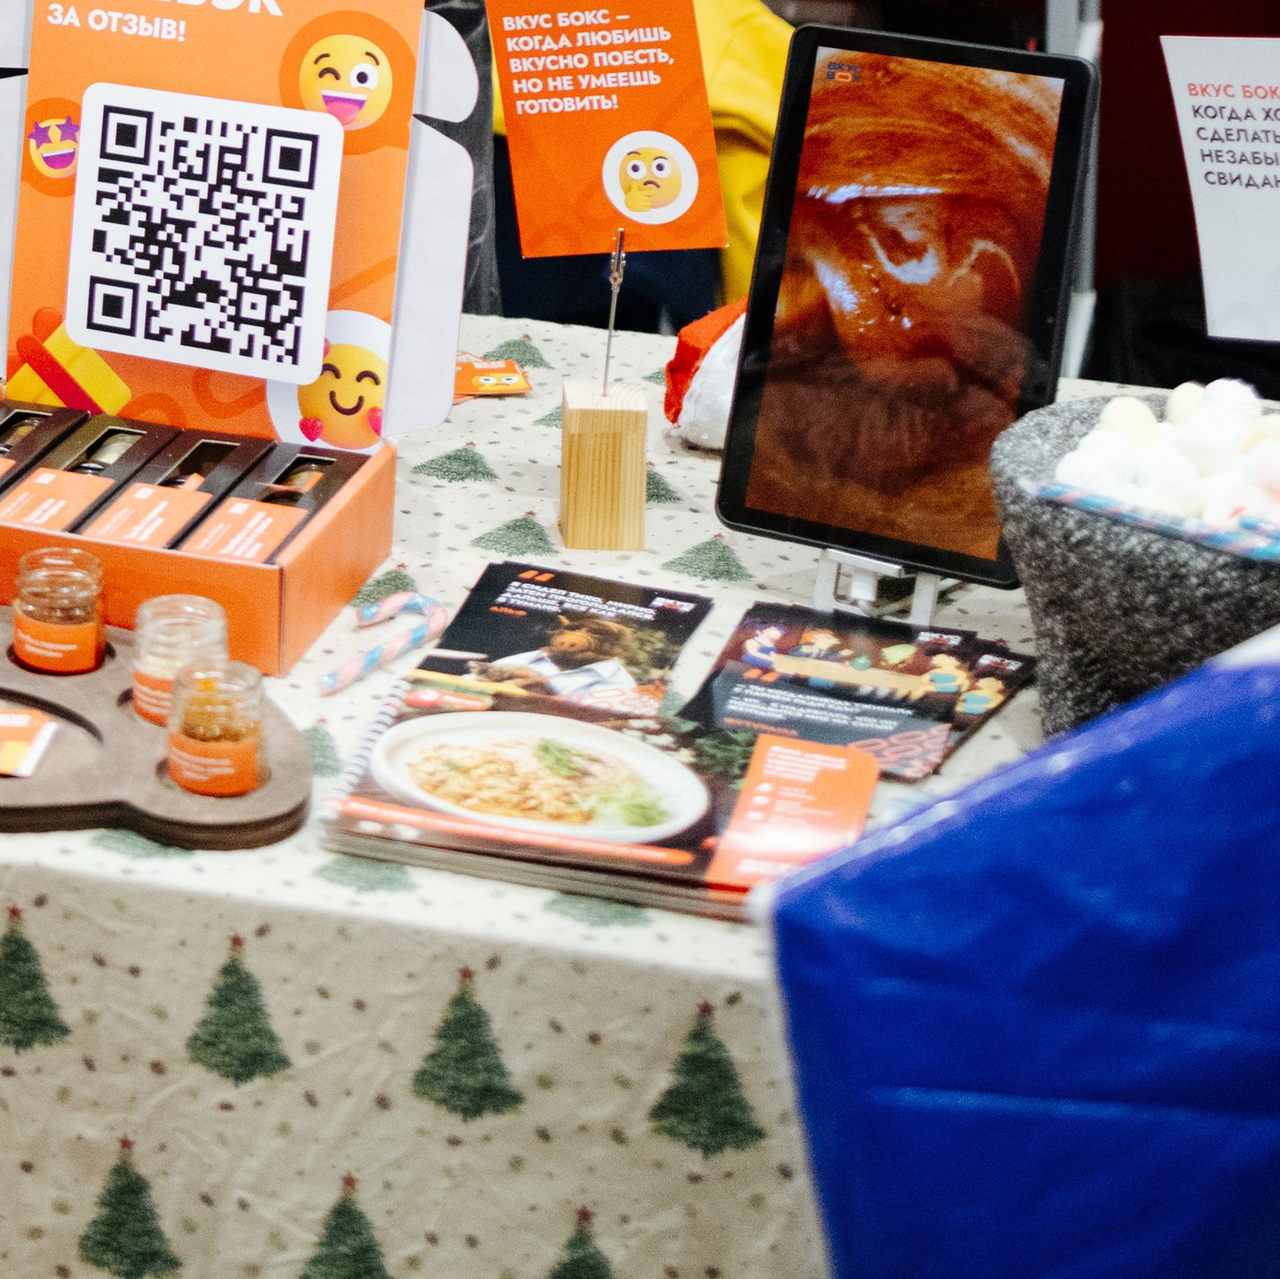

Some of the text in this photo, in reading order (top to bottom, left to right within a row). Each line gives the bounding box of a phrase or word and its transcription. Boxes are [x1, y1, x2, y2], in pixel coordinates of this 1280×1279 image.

[47, 3, 186, 42] ЗА ОТЗЫВ!
[502, 13, 552, 31] ВКУС
[557, 9, 611, 27] БОКС
[506, 26, 672, 52] КОГДА ЛЮБИШЬ
[509, 48, 675, 73] ВКУСНО ПОЕСТЬ,
[512, 70, 661, 94] НО НЕ УМЕЕШЬ
[1187, 83, 1236, 98] ВКУС
[516, 94, 619, 115] ГОТОВИТЬ!
[1192, 105, 1257, 122] КОГДА
[1196, 127, 1280, 144] СДЕЛАТЬ
